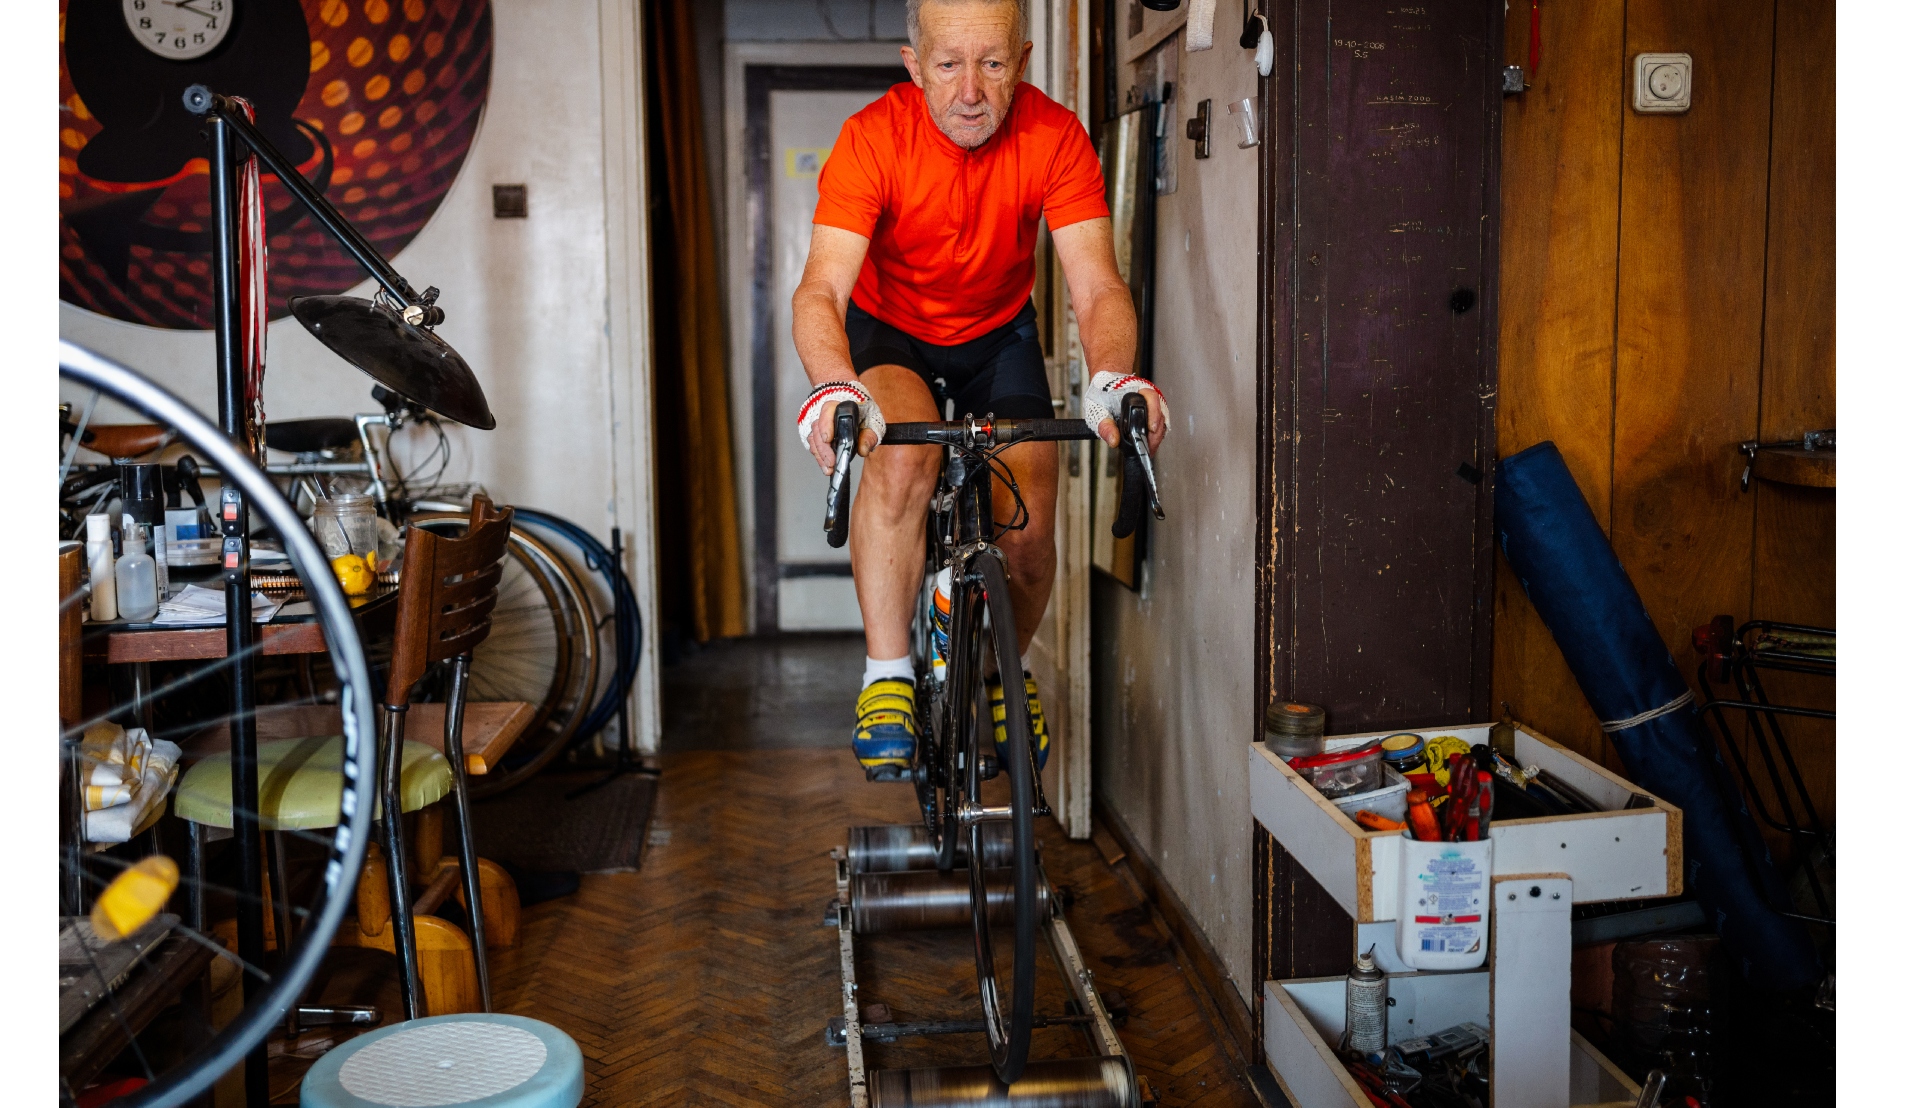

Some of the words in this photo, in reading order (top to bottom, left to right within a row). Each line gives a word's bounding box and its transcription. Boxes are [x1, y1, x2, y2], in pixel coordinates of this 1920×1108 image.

[134, 0, 146, 10] 9
[211, 1, 222, 12] 3
[140, 17, 151, 29] 8
[206, 18, 217, 30] 4
[155, 32, 166, 44] 7
[175, 37, 186, 49] 6
[194, 33, 205, 44] 5
